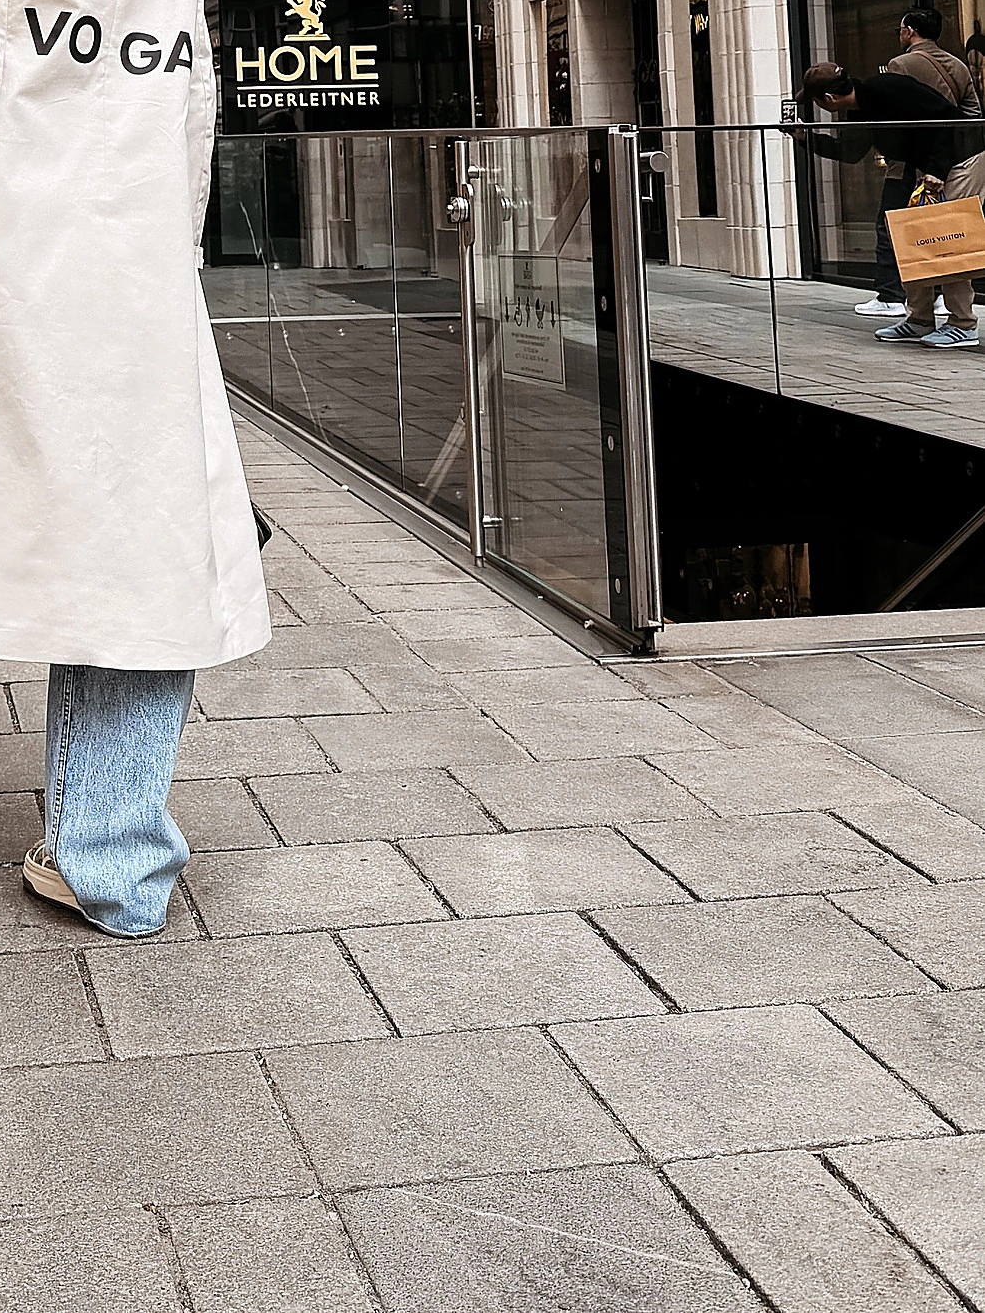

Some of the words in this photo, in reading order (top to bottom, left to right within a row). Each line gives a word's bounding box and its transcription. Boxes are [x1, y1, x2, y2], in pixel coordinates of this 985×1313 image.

[235, 44, 380, 82] HOME
[236, 91, 381, 108] LEDERLEITNER
[916, 237, 936, 246] LOUIS
